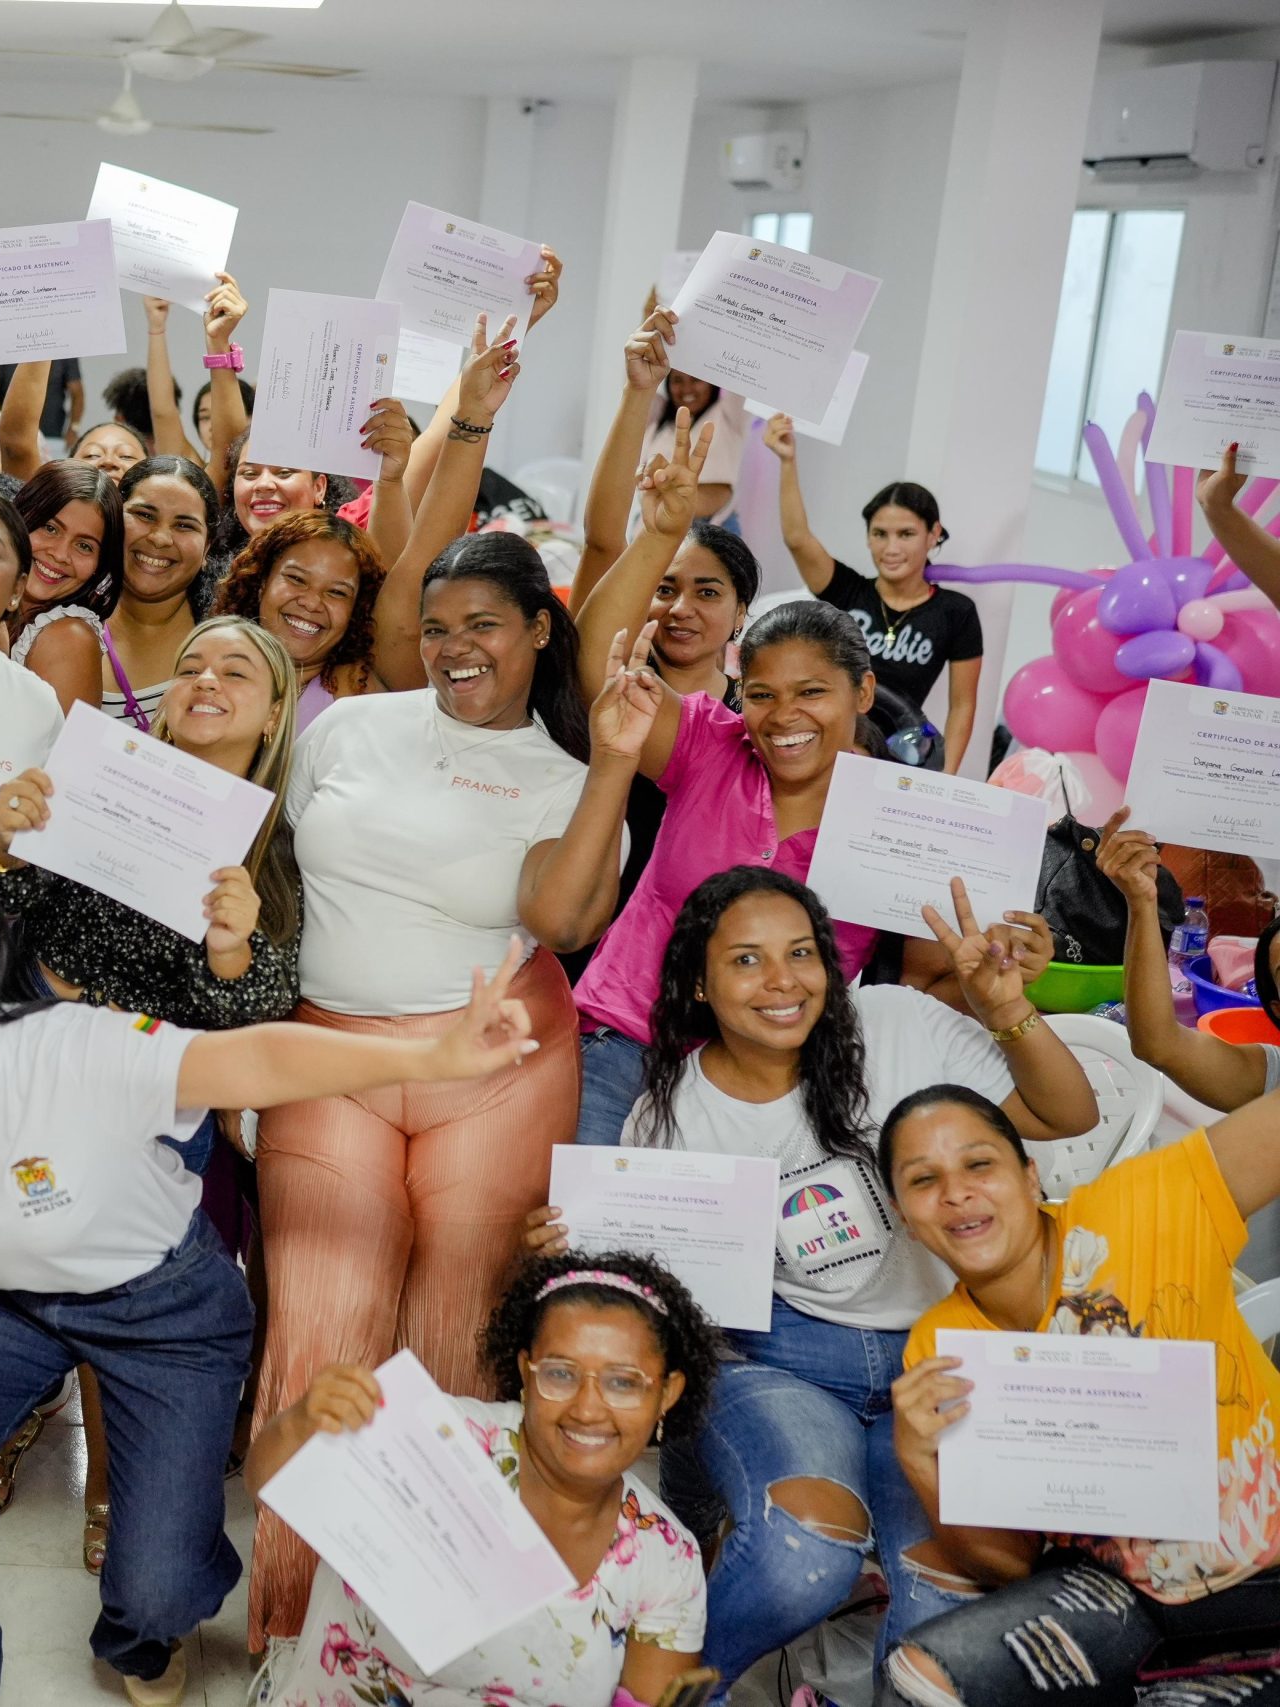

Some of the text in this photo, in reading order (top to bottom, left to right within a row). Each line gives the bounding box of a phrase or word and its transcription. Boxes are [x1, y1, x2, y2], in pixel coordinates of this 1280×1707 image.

[32, 259, 70, 269] ASISTENCIA
[429, 242, 504, 272] CERTIFICADO DE ASISTENCIA
[727, 271, 819, 308] CERTIFICADO DE ASISTENCIA
[1208, 369, 1252, 380] CERTIFICADO
[345, 342, 363, 432] CERTIFICADO DE ASISTENCIA
[1195, 730, 1252, 746] CERTIFICADO
[1252, 739, 1265, 748] DE
[1190, 755, 1223, 770] Dayana
[101, 763, 151, 792] CERTIFICADO
[148, 785, 162, 797] DE
[161, 791, 205, 818] ASISTENCIA
[451, 776, 521, 799] FRANCYS
[879, 804, 994, 836] CERTIFICADO DE ASISTENCIA
[657, 1194, 669, 1202] DE
[671, 1195, 720, 1207] ASISTENCIA
[796, 1224, 861, 1258] AUTUMN
[1002, 1382, 1143, 1400] CERTIFICADO DE ASISTENCIA
